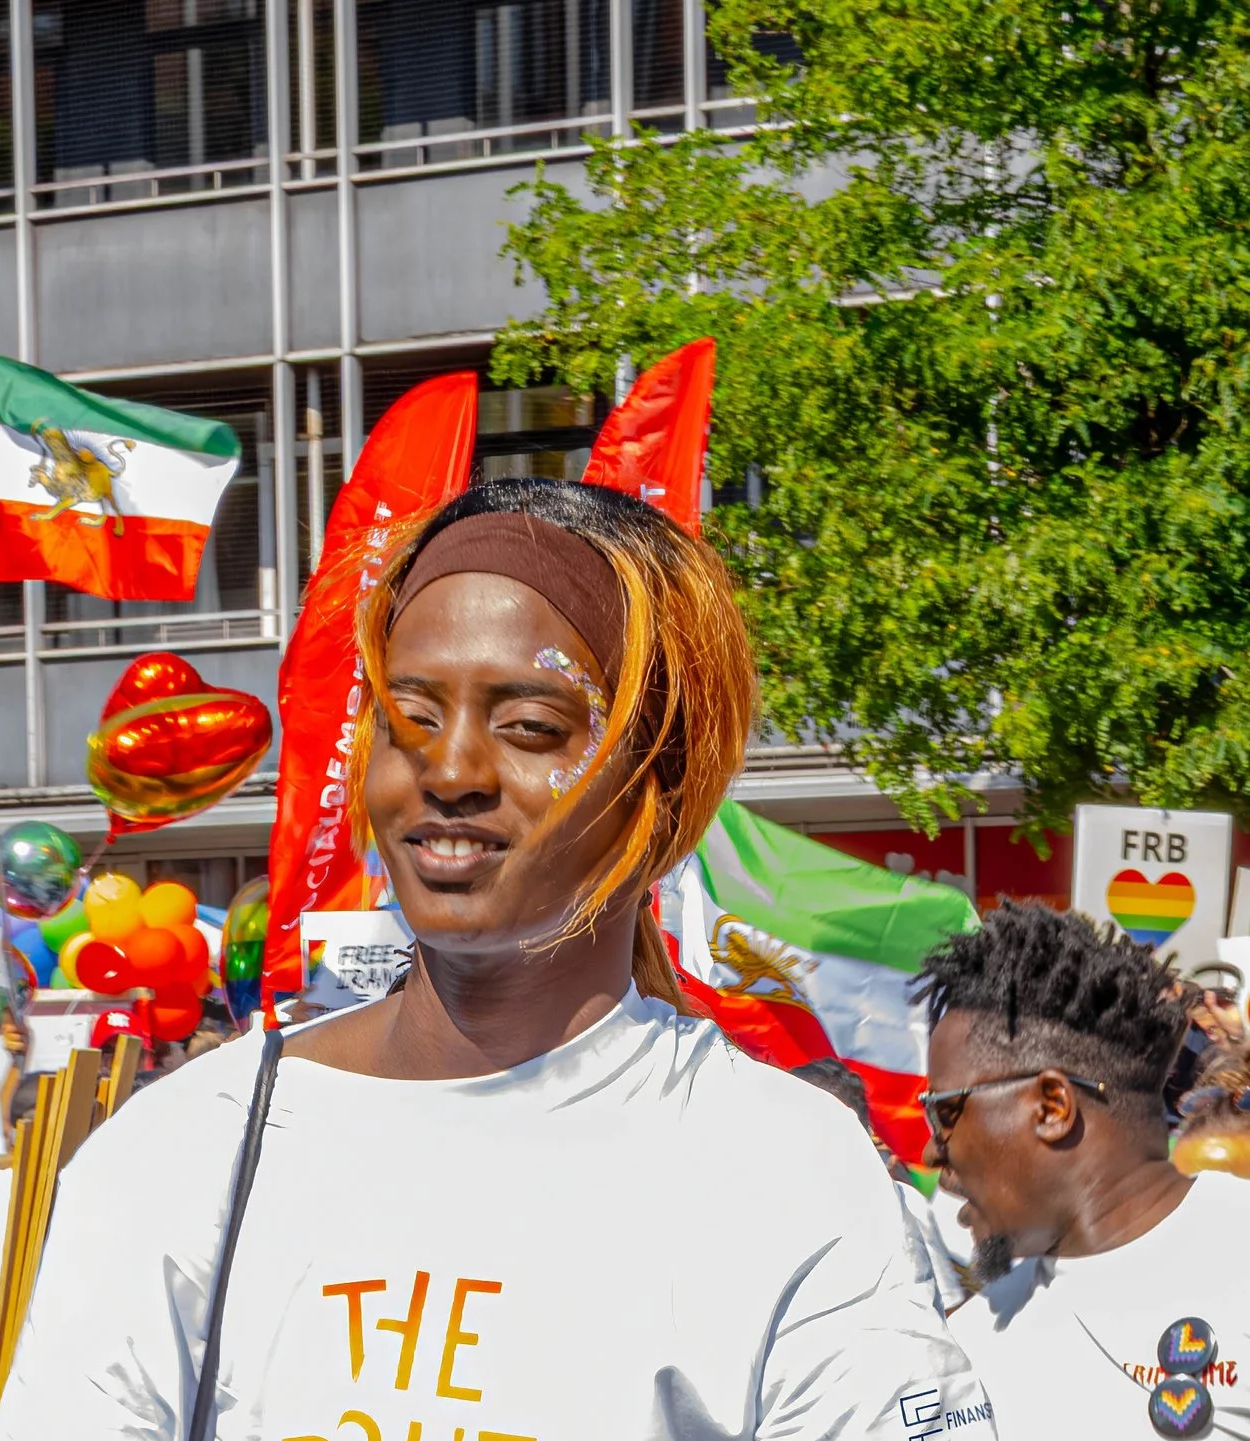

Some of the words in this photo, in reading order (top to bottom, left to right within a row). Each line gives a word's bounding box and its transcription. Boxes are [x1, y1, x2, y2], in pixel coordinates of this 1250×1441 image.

[1121, 829, 1189, 863] FRB
[337, 944, 395, 965] FREE
[323, 1270, 503, 1402] THE
